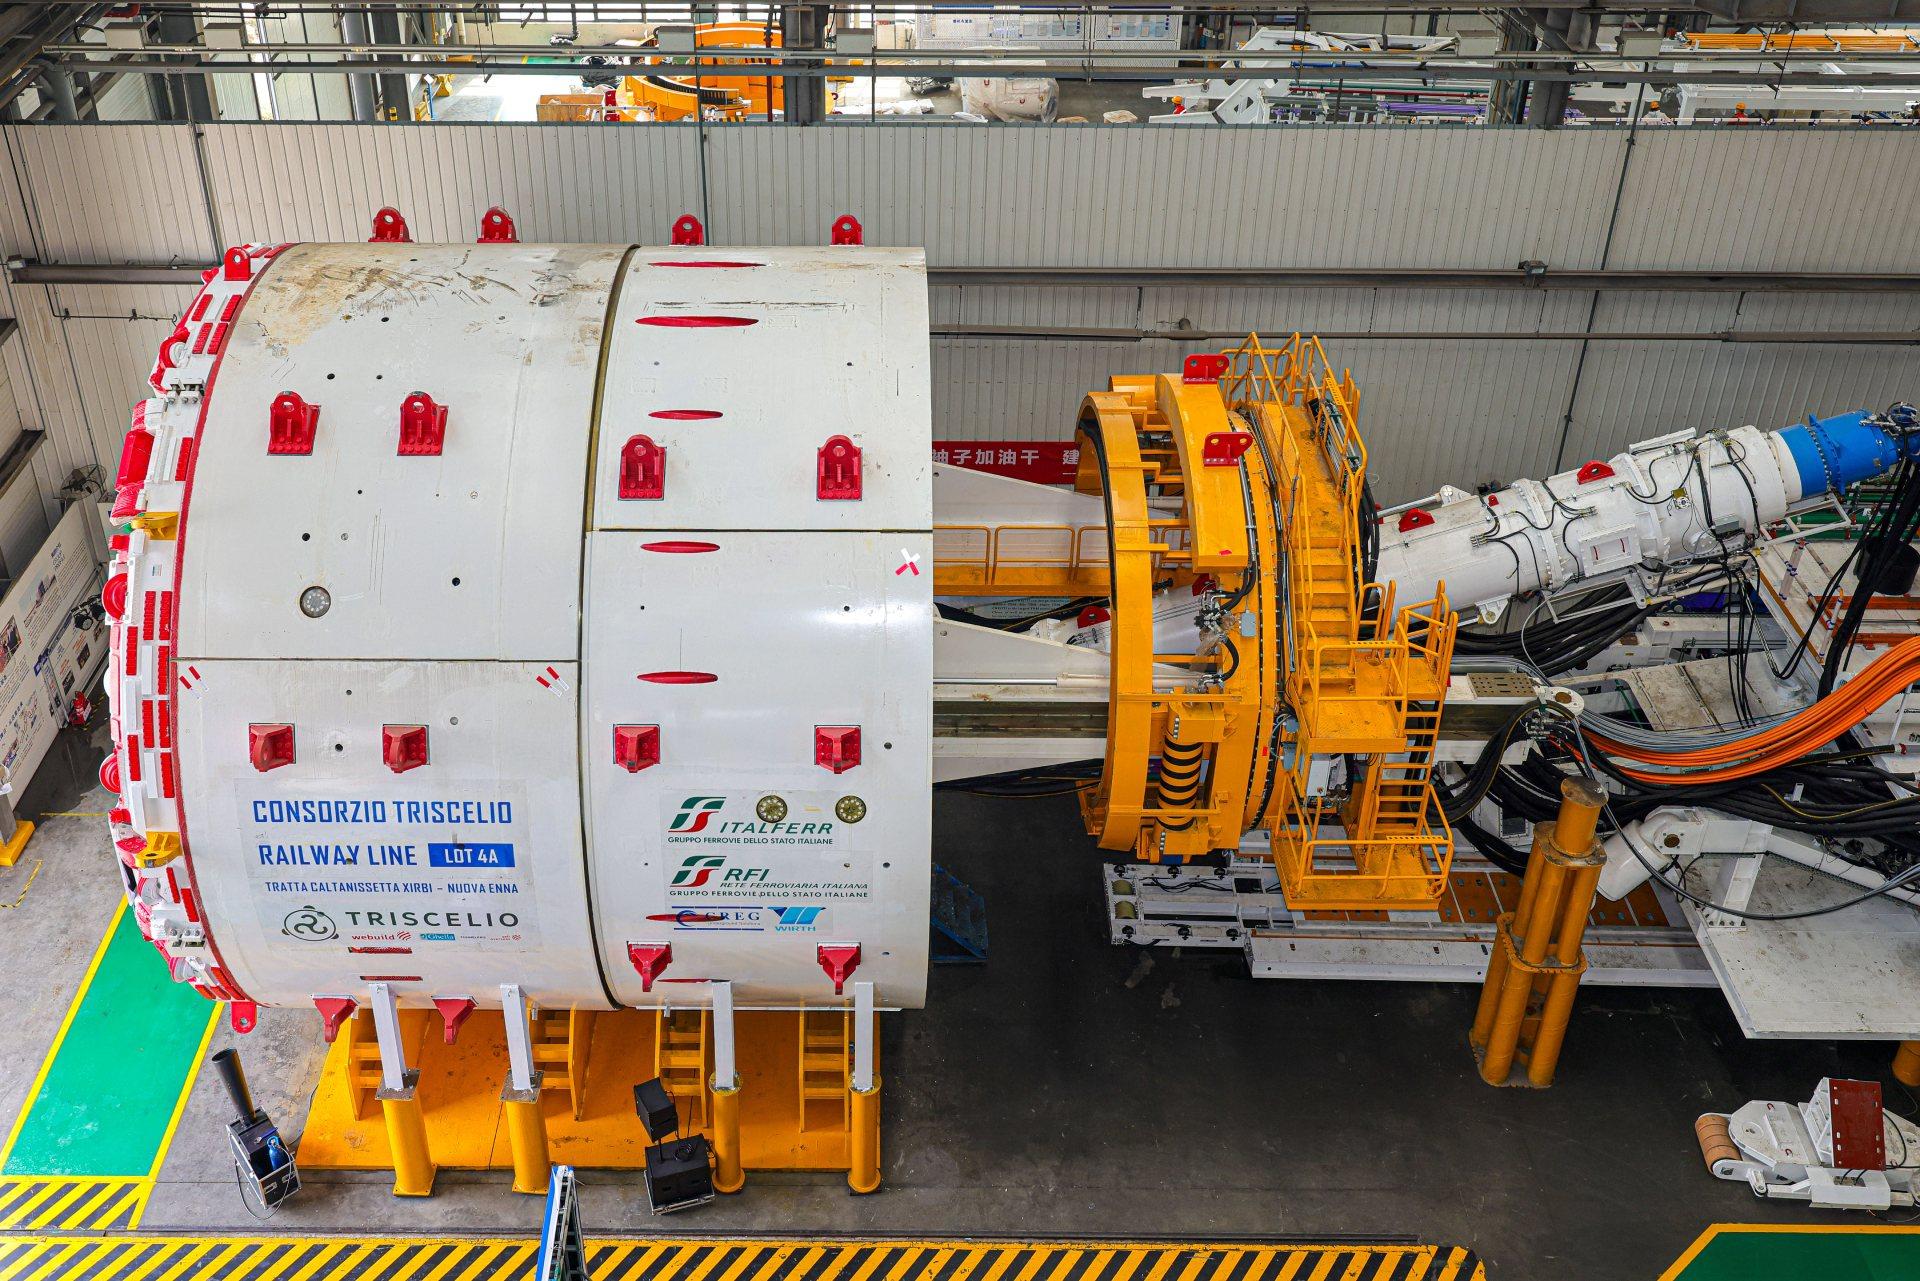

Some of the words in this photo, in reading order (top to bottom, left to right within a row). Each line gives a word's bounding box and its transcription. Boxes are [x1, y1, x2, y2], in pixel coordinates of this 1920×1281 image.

[253, 801, 386, 823] CONSORZIO
[393, 801, 513, 824] TRISCELIO
[720, 822, 833, 834] ITALFERR
[258, 845, 359, 865] RAILWAY
[367, 845, 417, 865] LINE
[444, 849, 473, 864] LOT
[477, 850, 499, 864] 4A
[724, 869, 769, 881] RFI
[265, 882, 308, 892] TRATTA
[310, 882, 399, 893] CALTANISSETTA
[403, 883, 432, 893] XIRBI
[448, 883, 486, 893] NUOVA
[489, 883, 518, 893] ENNA
[345, 911, 519, 927] TRISCELIO
